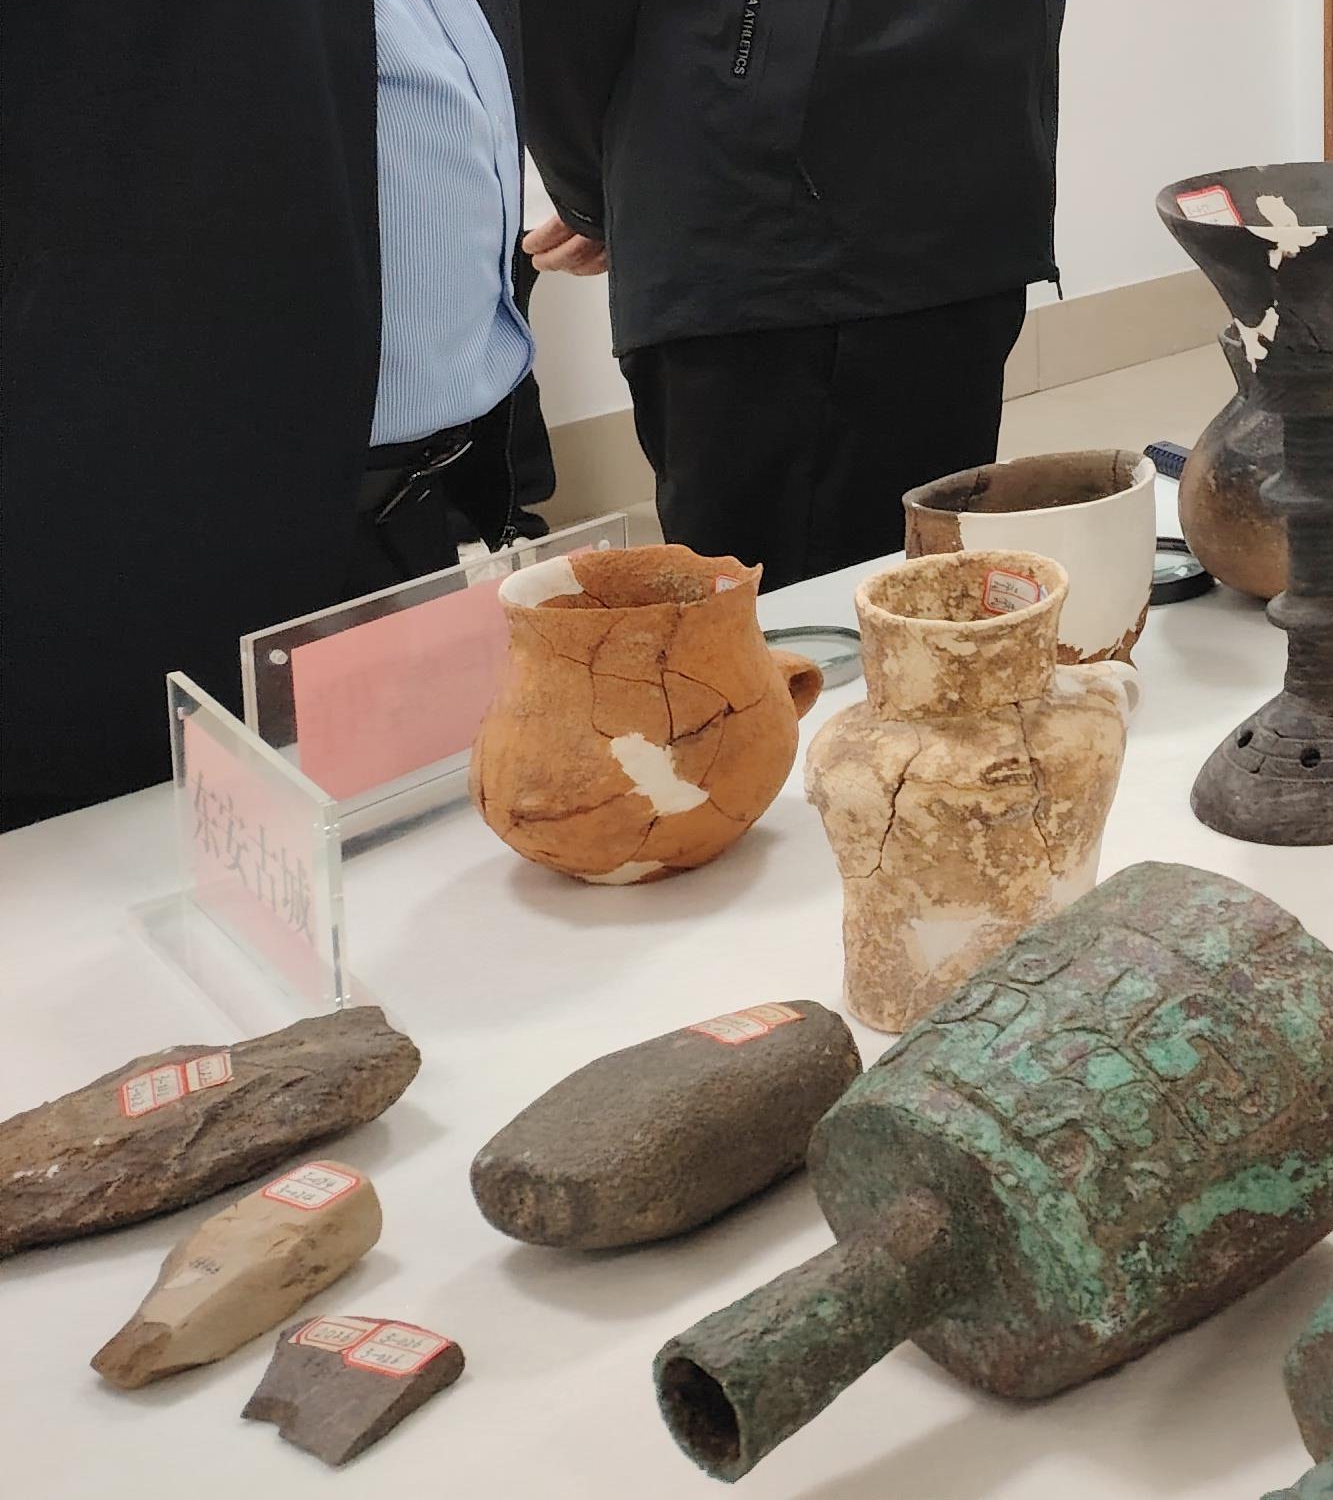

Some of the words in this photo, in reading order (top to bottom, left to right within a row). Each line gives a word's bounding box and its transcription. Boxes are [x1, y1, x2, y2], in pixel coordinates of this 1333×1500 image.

[734, 8, 756, 75] ATHLETICS
[191, 771, 315, 947] 东安古城
